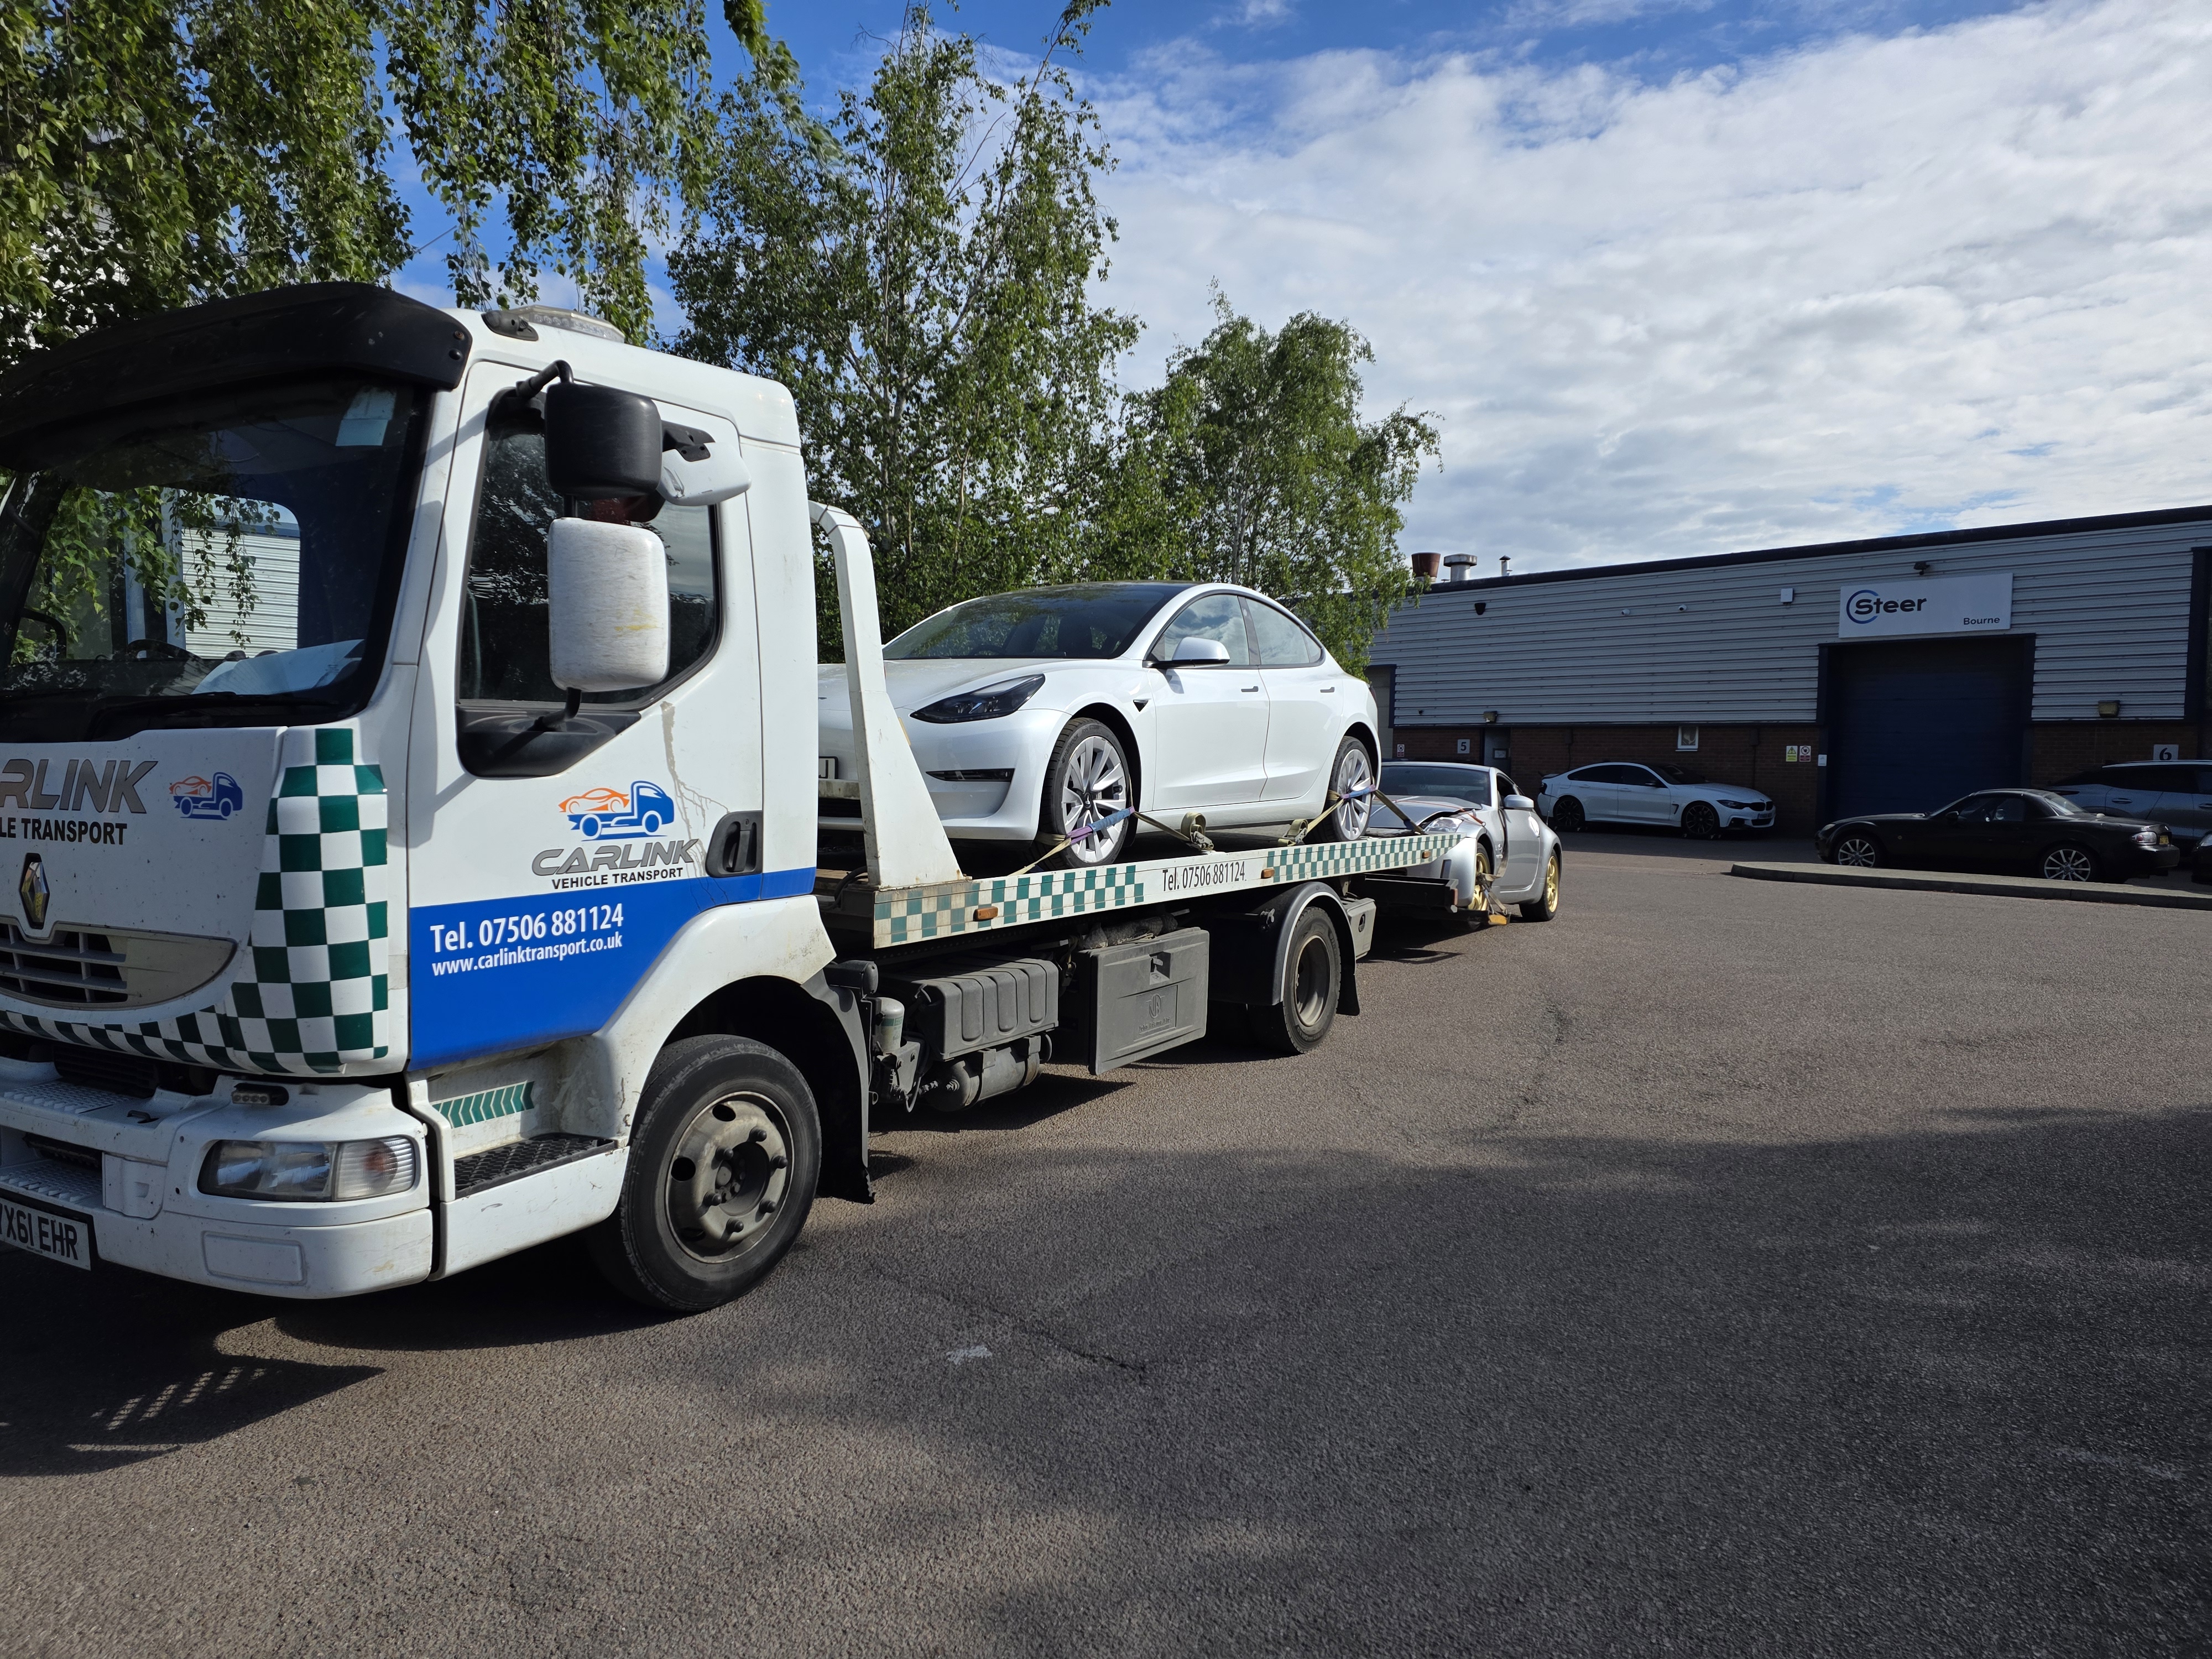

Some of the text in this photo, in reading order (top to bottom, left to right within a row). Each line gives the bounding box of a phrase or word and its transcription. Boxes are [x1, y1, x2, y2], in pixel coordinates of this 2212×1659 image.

[1854, 597, 1927, 615] Steer
[1963, 617, 2001, 626] Bourne
[1460, 742, 1467, 751] 5
[2159, 747, 2172, 761] 6
[21, 817, 128, 846] TRANSPORT
[531, 838, 700, 877] CARLINK
[551, 867, 684, 890] VEHICLE TRANSPORT
[1162, 867, 1180, 891] Tel.
[1182, 864, 1211, 889] 07506
[430, 902, 624, 953] Tel. 07506 881124
[431, 931, 623, 977] www.carlinktransport.co.uk
[37, 1215, 79, 1261] EHR
